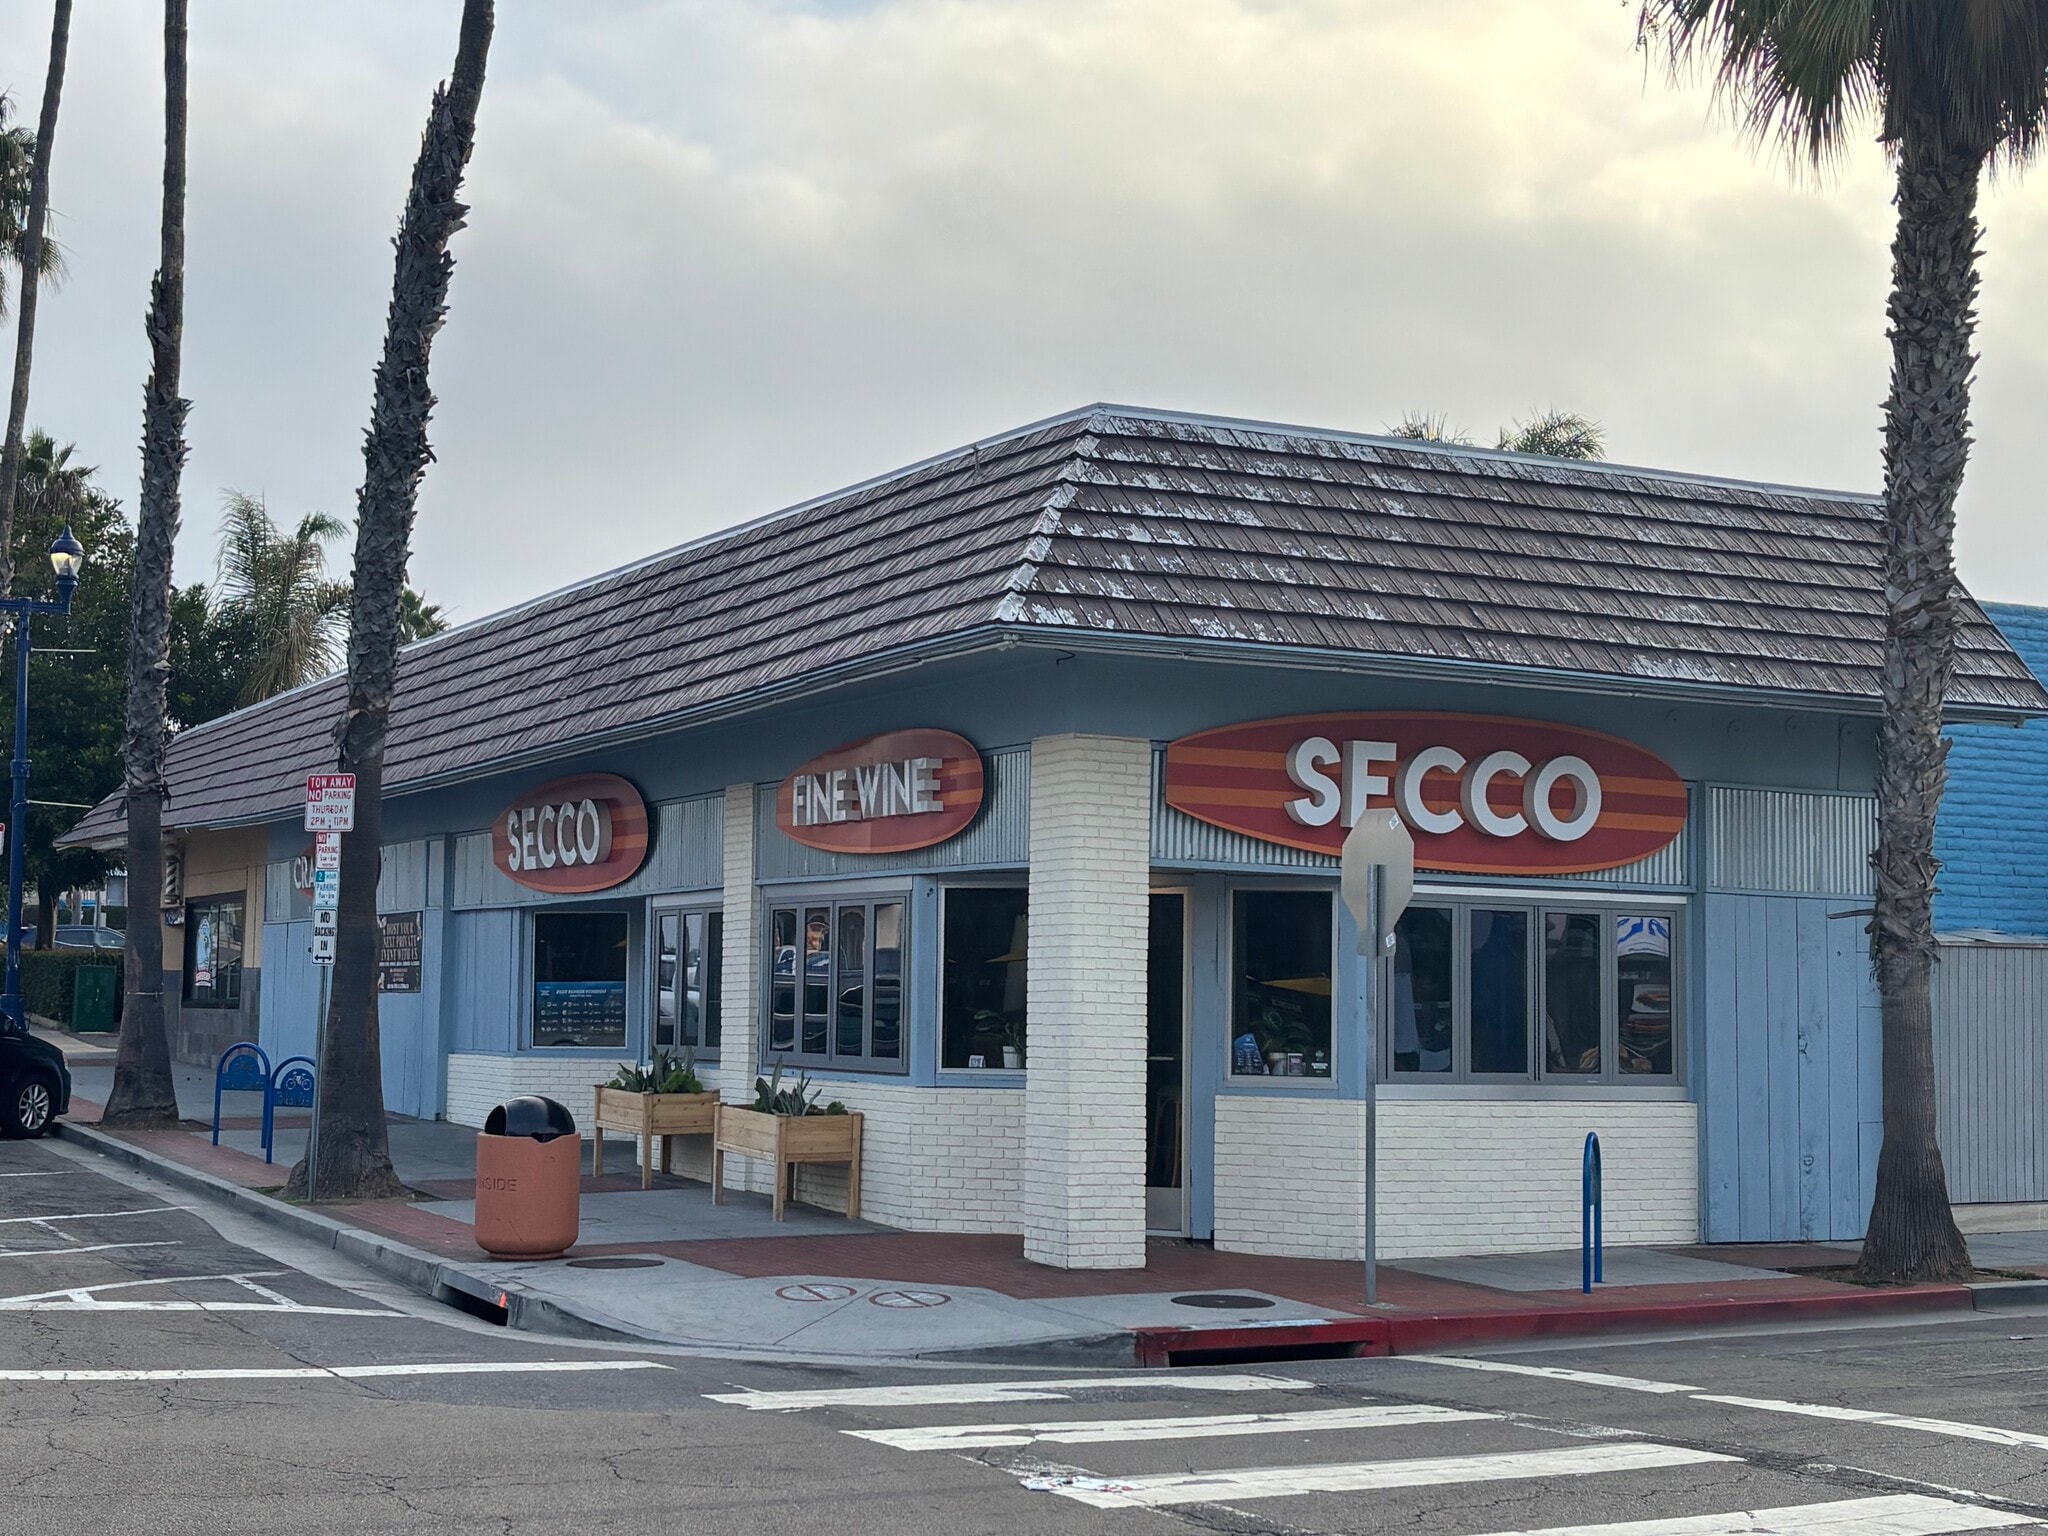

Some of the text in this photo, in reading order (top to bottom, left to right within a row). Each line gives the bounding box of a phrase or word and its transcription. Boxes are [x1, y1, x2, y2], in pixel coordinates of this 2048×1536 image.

[311, 776, 353, 788] TOW AWAY
[308, 790, 352, 801] NO PARKING
[793, 757, 943, 827] FINE WINE
[310, 816, 326, 826] 2PM
[507, 798, 602, 872] SECCO
[320, 911, 331, 924] NO
[314, 926, 335, 937] BACKING
[320, 940, 329, 951] IN
